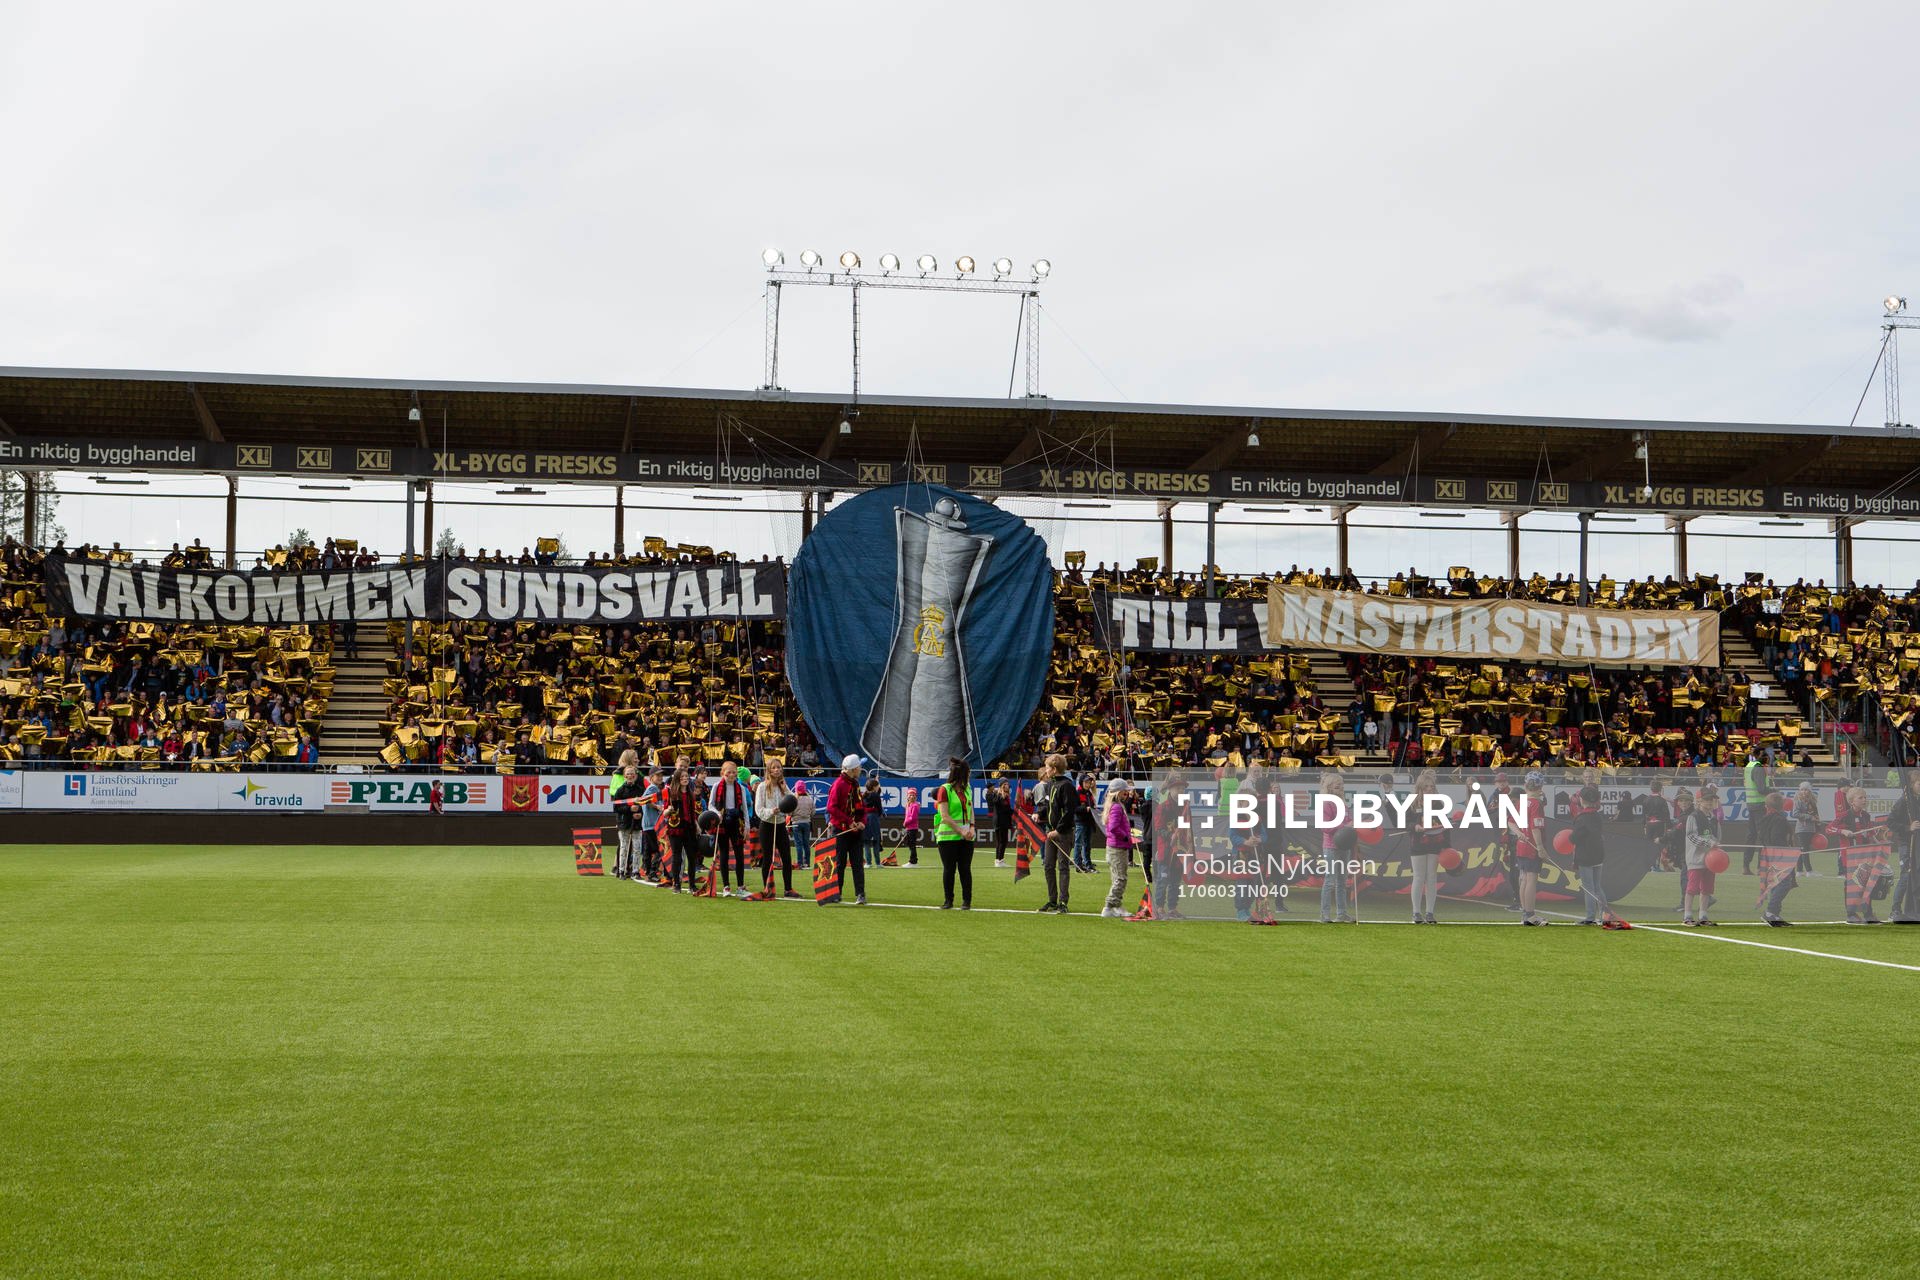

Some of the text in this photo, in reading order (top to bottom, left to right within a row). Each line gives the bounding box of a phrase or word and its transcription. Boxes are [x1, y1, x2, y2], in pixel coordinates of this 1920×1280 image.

[0, 441, 196, 465] En riktig bygghandel
[433, 453, 617, 475] XL-BYGG FRESKS
[638, 459, 820, 482] En riktig bygghandel
[1039, 469, 1211, 492] XL-BYGG FRESKS
[1231, 477, 1400, 498] En riktig bygghandel
[1605, 486, 1764, 506] XL-BYGG FRESKS
[1783, 492, 1804, 507] En
[1809, 493, 1849, 511] riktig
[64, 561, 427, 622] VÄLKOMMEN
[447, 567, 774, 620] SUNDSVALL
[1112, 598, 1238, 650] TILL
[1281, 590, 1701, 661] MÄSTARSTADEN
[91, 774, 179, 787] Länsförsäkringar
[91, 787, 137, 797] Jämtland
[255, 794, 303, 806] bravida
[348, 781, 468, 804] PEAB
